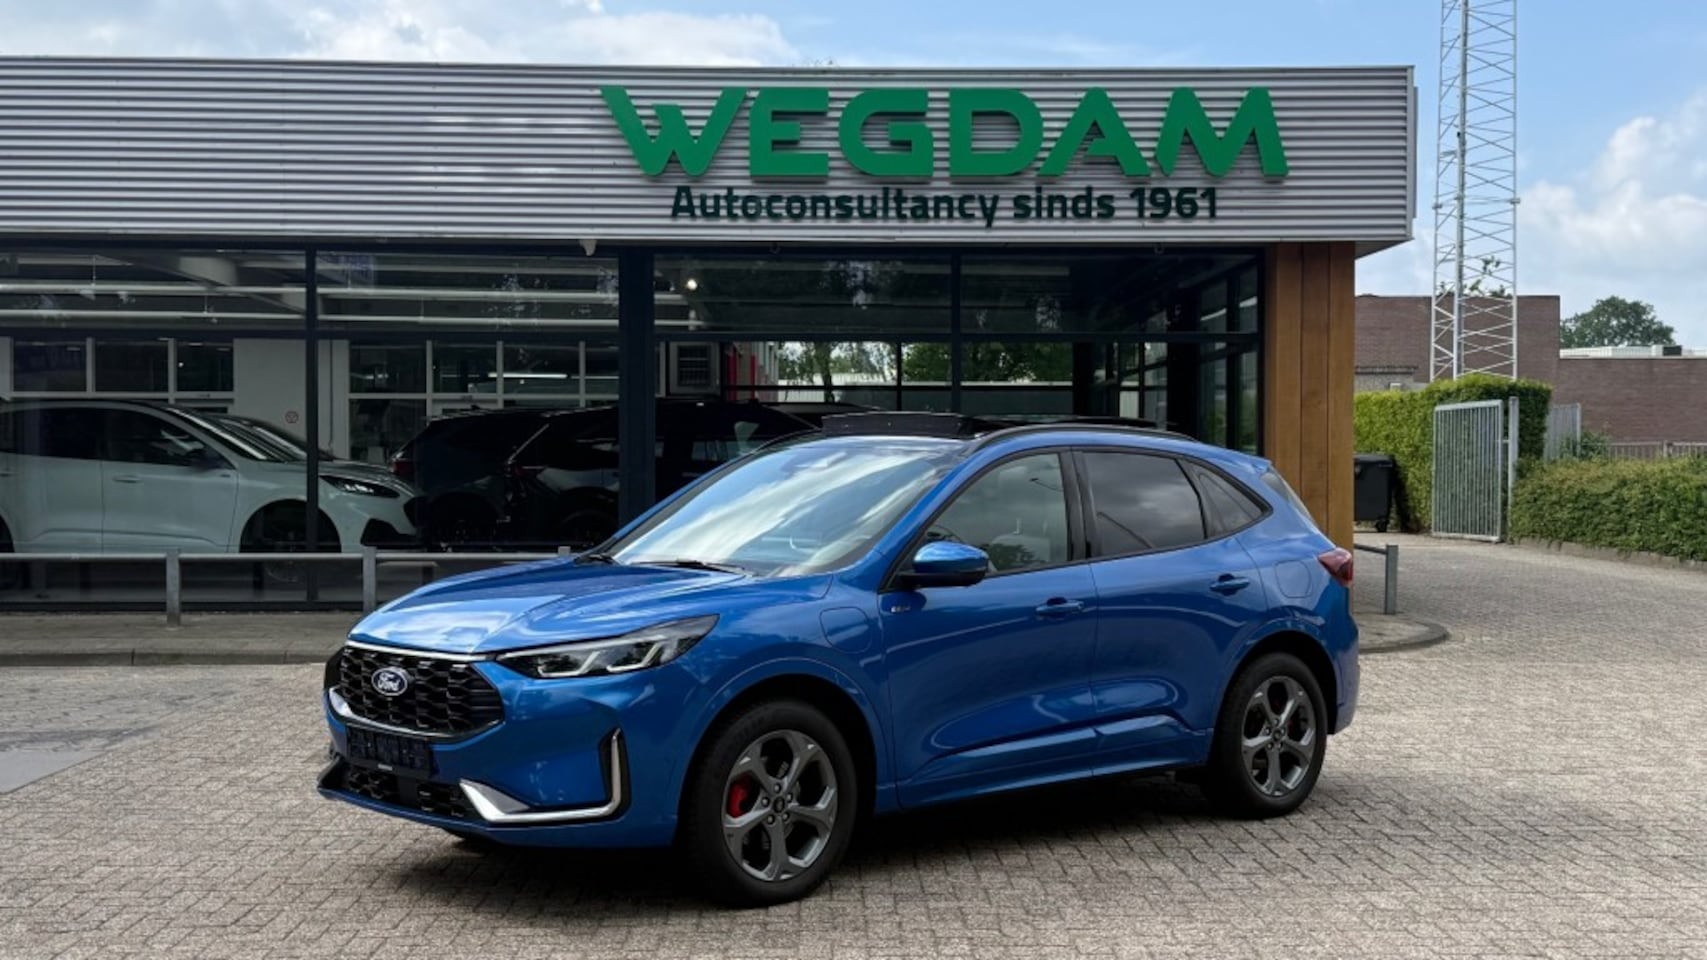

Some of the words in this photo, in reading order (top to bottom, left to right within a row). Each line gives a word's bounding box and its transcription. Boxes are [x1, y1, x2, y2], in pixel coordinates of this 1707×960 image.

[603, 87, 1288, 176] WEGDAM
[671, 185, 999, 229] Autoconsultancy
[1013, 185, 1116, 219] sinds
[1129, 187, 1217, 219] 1961
